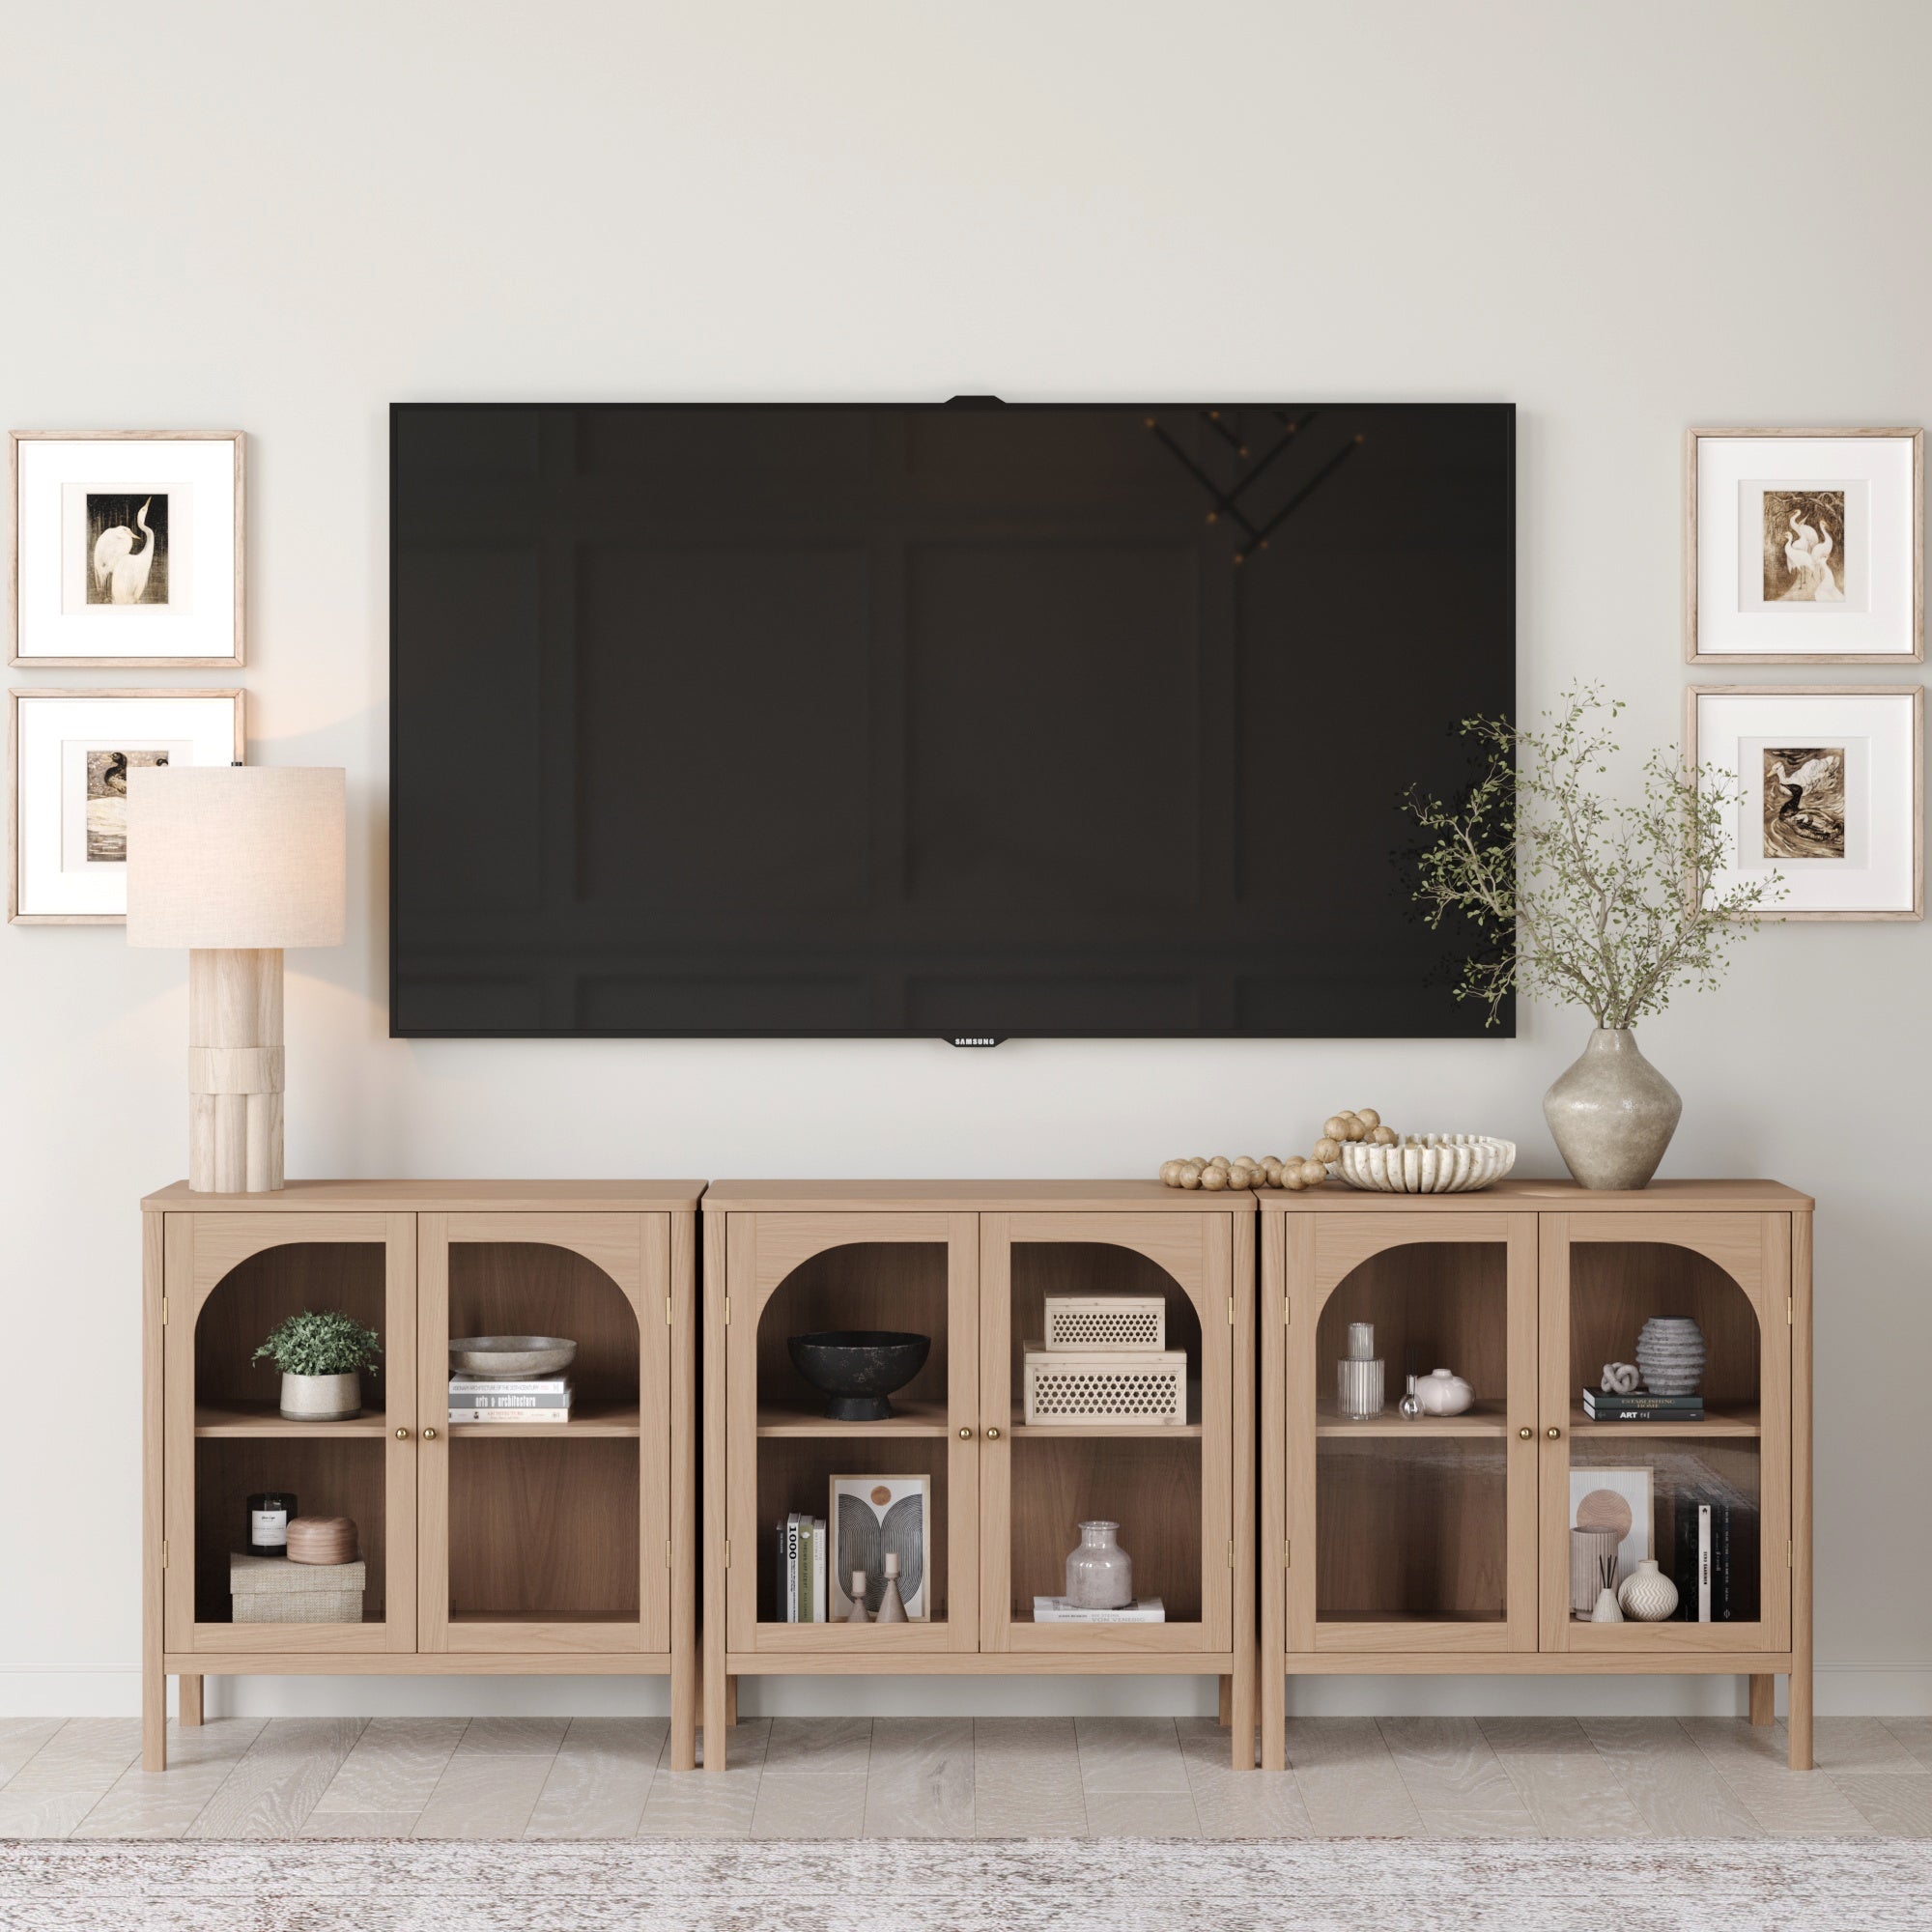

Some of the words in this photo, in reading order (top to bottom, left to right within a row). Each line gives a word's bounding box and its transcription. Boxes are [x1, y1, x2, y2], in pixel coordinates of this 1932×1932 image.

[475, 1395, 489, 1407] arts
[497, 1395, 536, 1407] architecture
[788, 1526, 797, 1560] 1000
